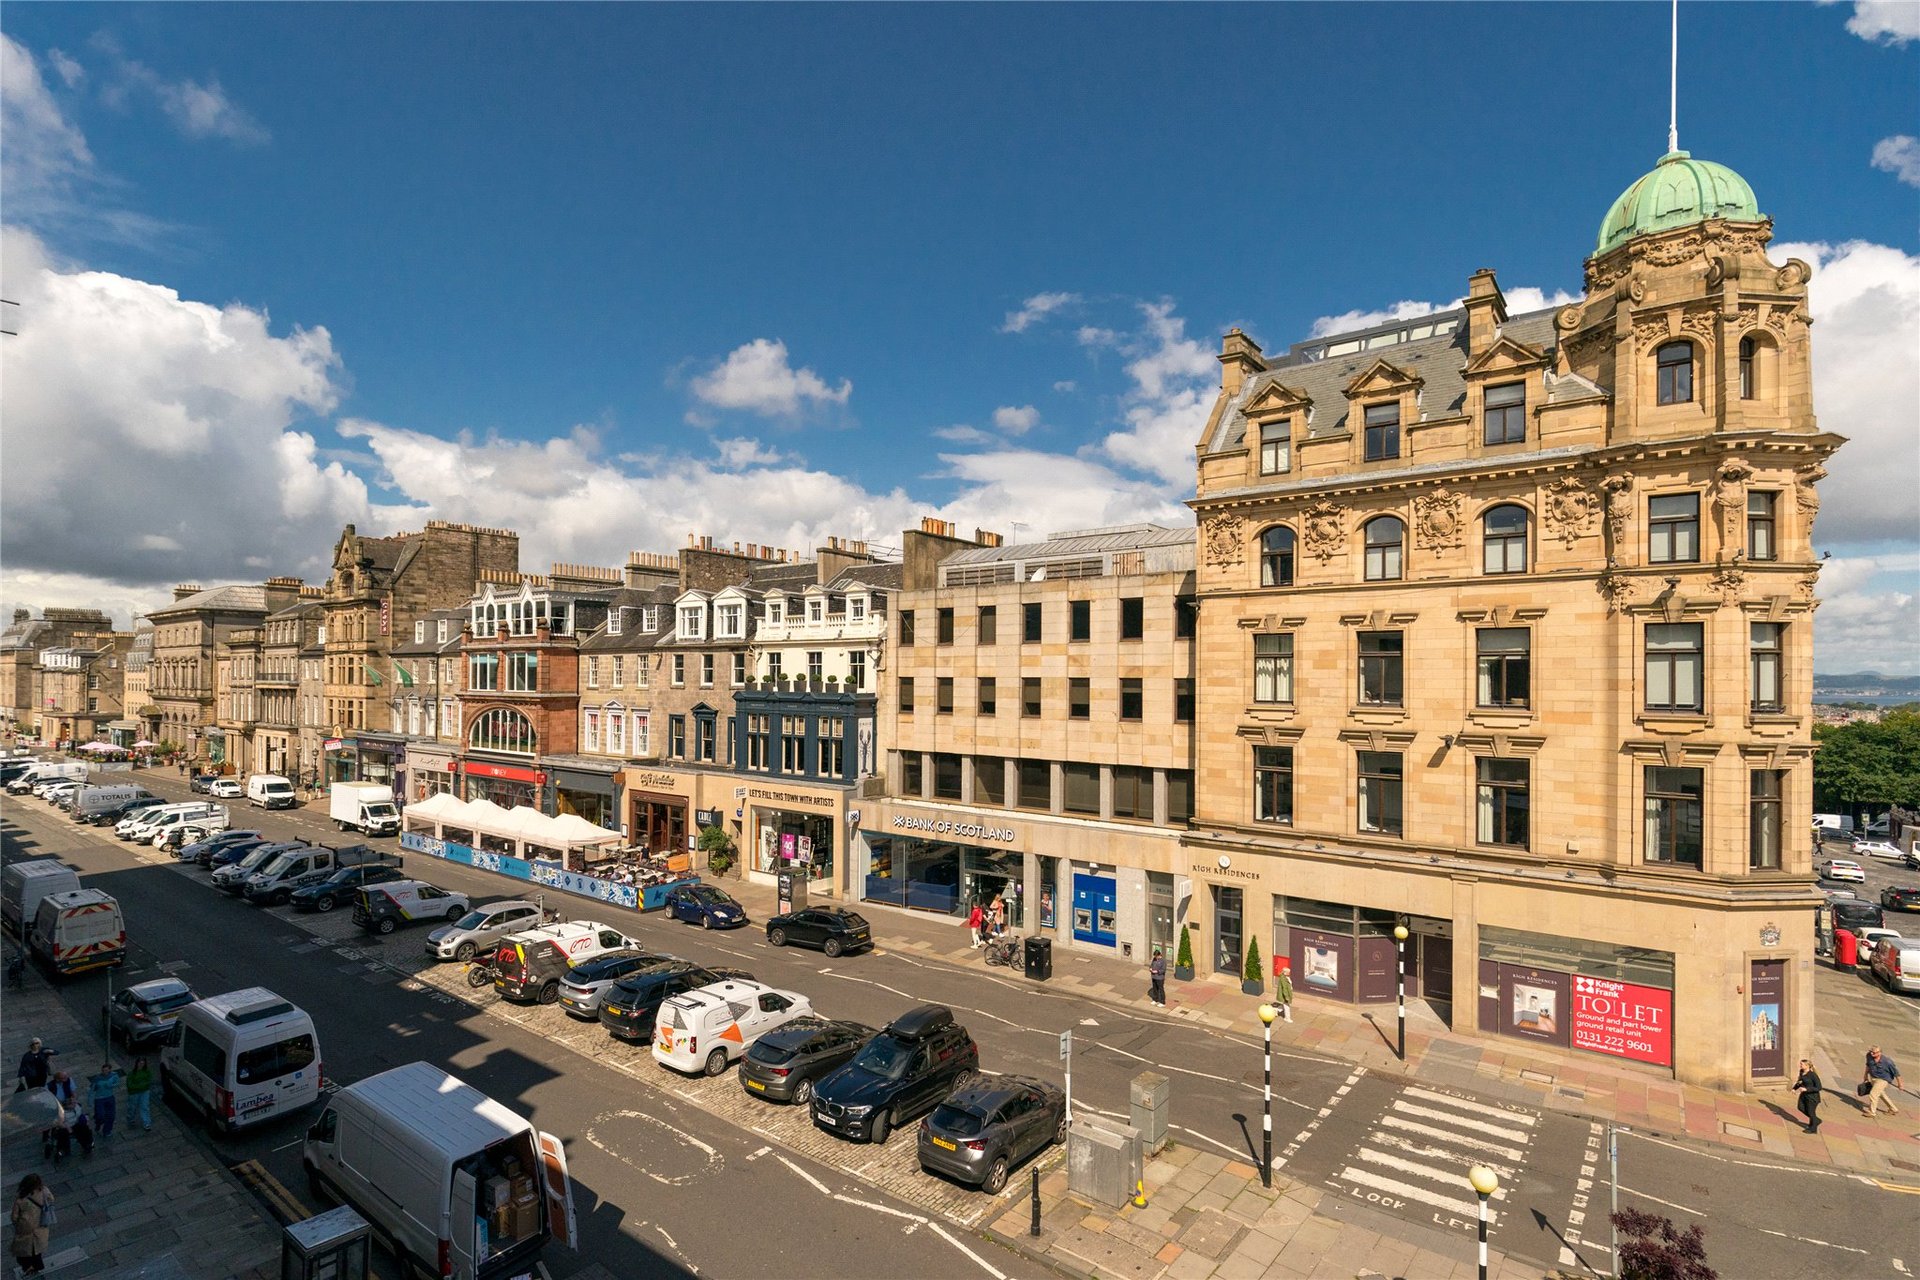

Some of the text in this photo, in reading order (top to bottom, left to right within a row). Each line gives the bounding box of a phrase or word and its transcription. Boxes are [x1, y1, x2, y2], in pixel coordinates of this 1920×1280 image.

[101, 793, 131, 801] TOTALIS
[749, 788, 835, 807] LET'S FILL THIS TOWN WITH ARTISTS
[906, 817, 1016, 843] BANK OF SCOTLAND
[1213, 867, 1260, 880] RESIDENCES
[1595, 979, 1624, 993] Knight
[1595, 987, 1619, 999] Frank
[1576, 1011, 1662, 1033] Ground and part lower
[1576, 1020, 1642, 1038] ground retail unit
[1576, 1030, 1654, 1053] 0131 222 9601
[1350, 1187, 1406, 1210] LOOK
